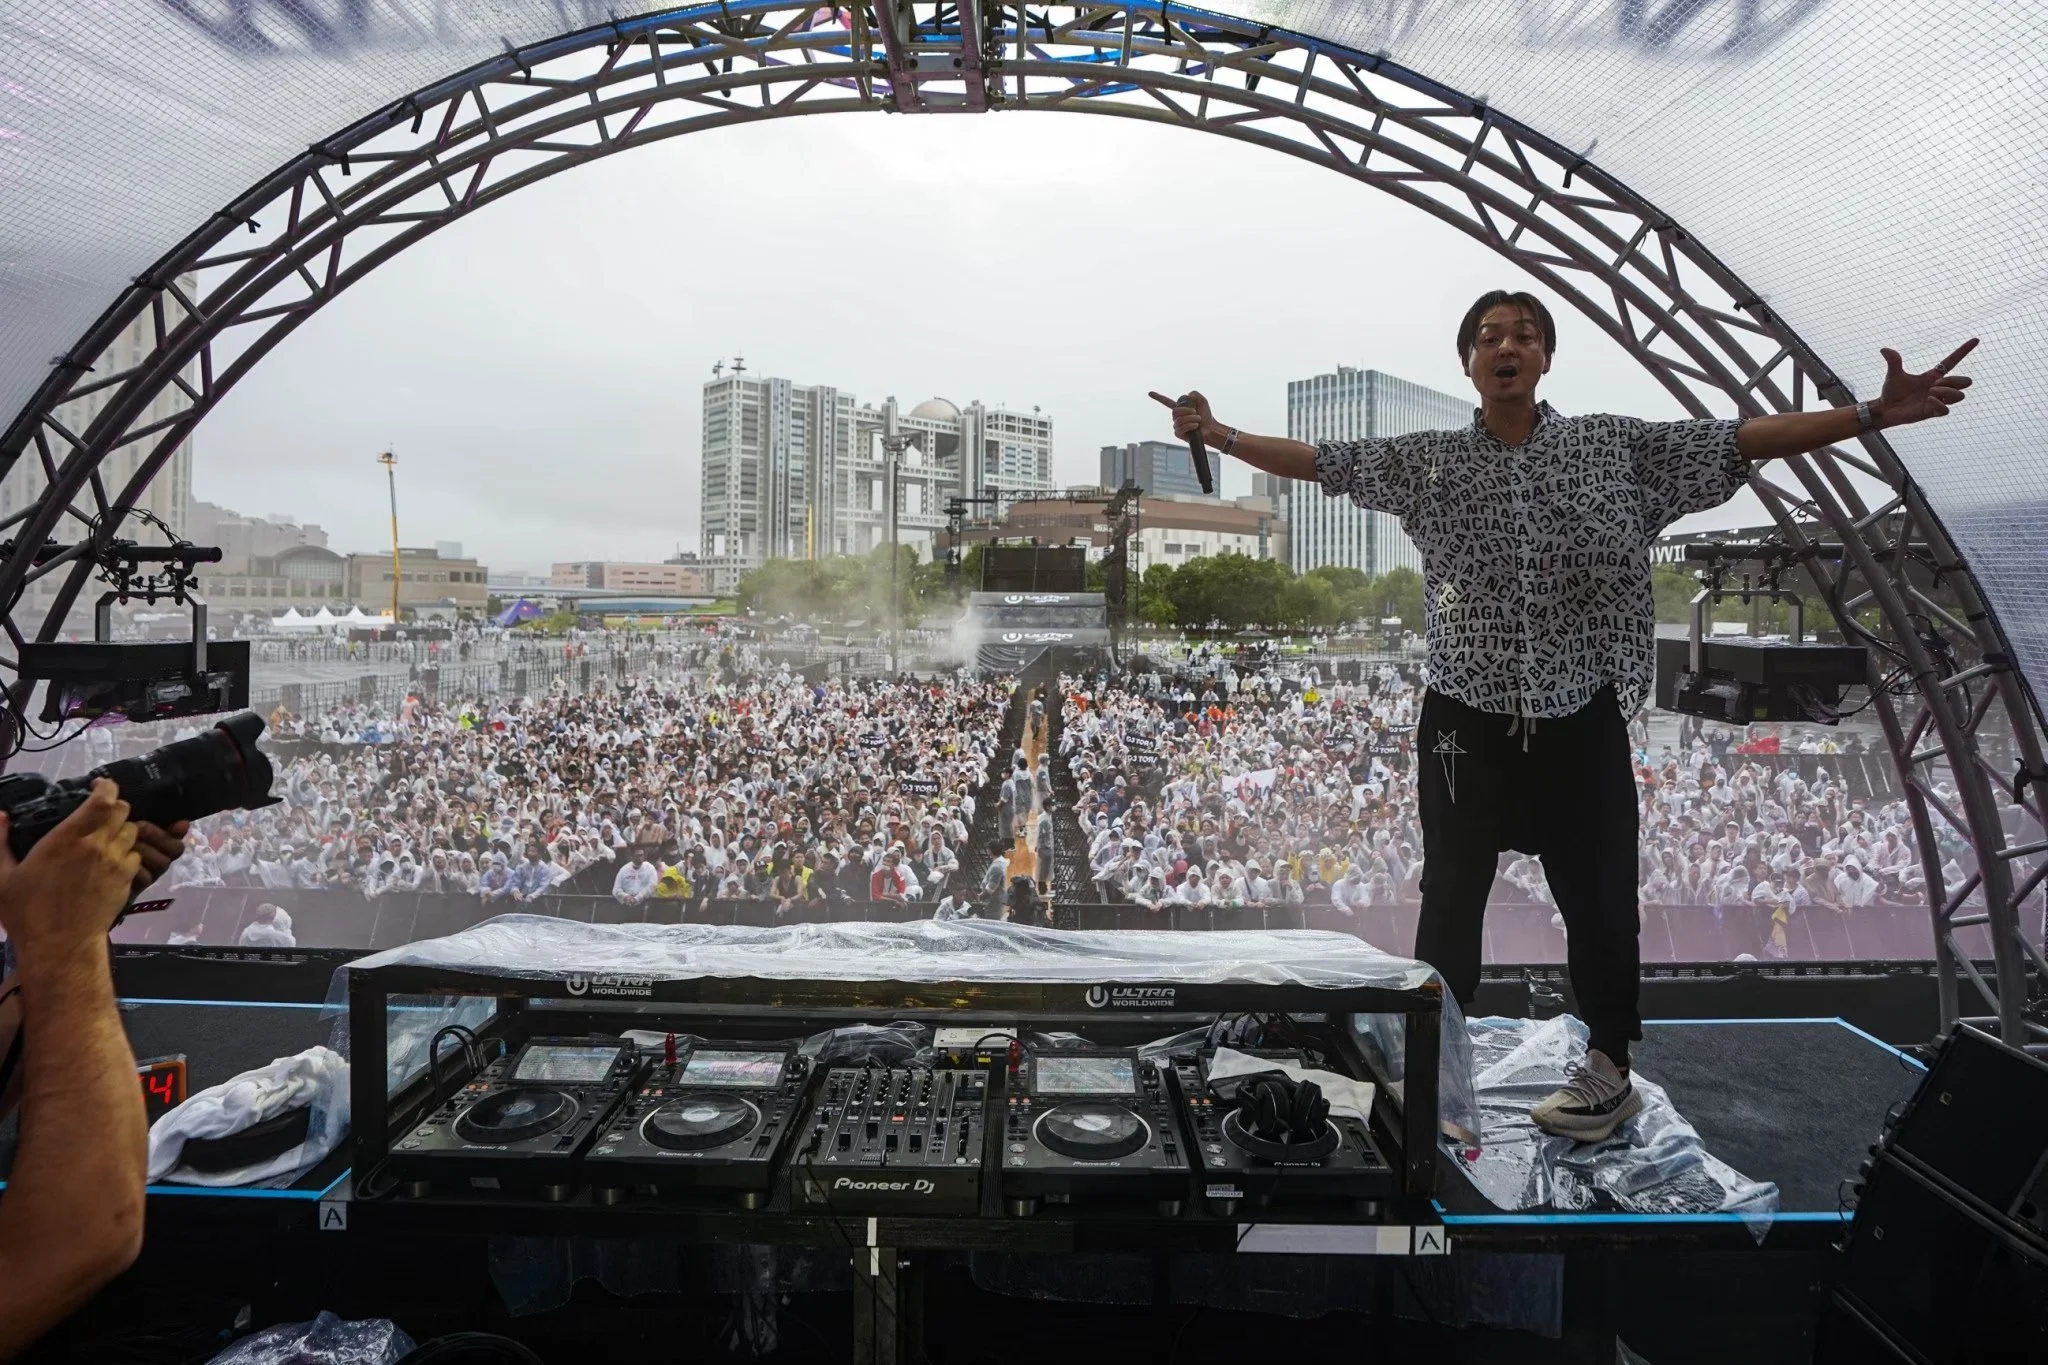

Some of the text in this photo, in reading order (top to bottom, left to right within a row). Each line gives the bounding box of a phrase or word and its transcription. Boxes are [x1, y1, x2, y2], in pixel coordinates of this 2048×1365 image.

[1515, 551, 1632, 571] BALENCIAGA
[901, 783, 914, 792] DJ
[592, 987, 653, 996] WORLDWIDE
[1112, 987, 1176, 998] ULTRA
[833, 1177, 910, 1191] Pioneer
[324, 1207, 344, 1228] A
[1420, 1231, 1441, 1251] A
